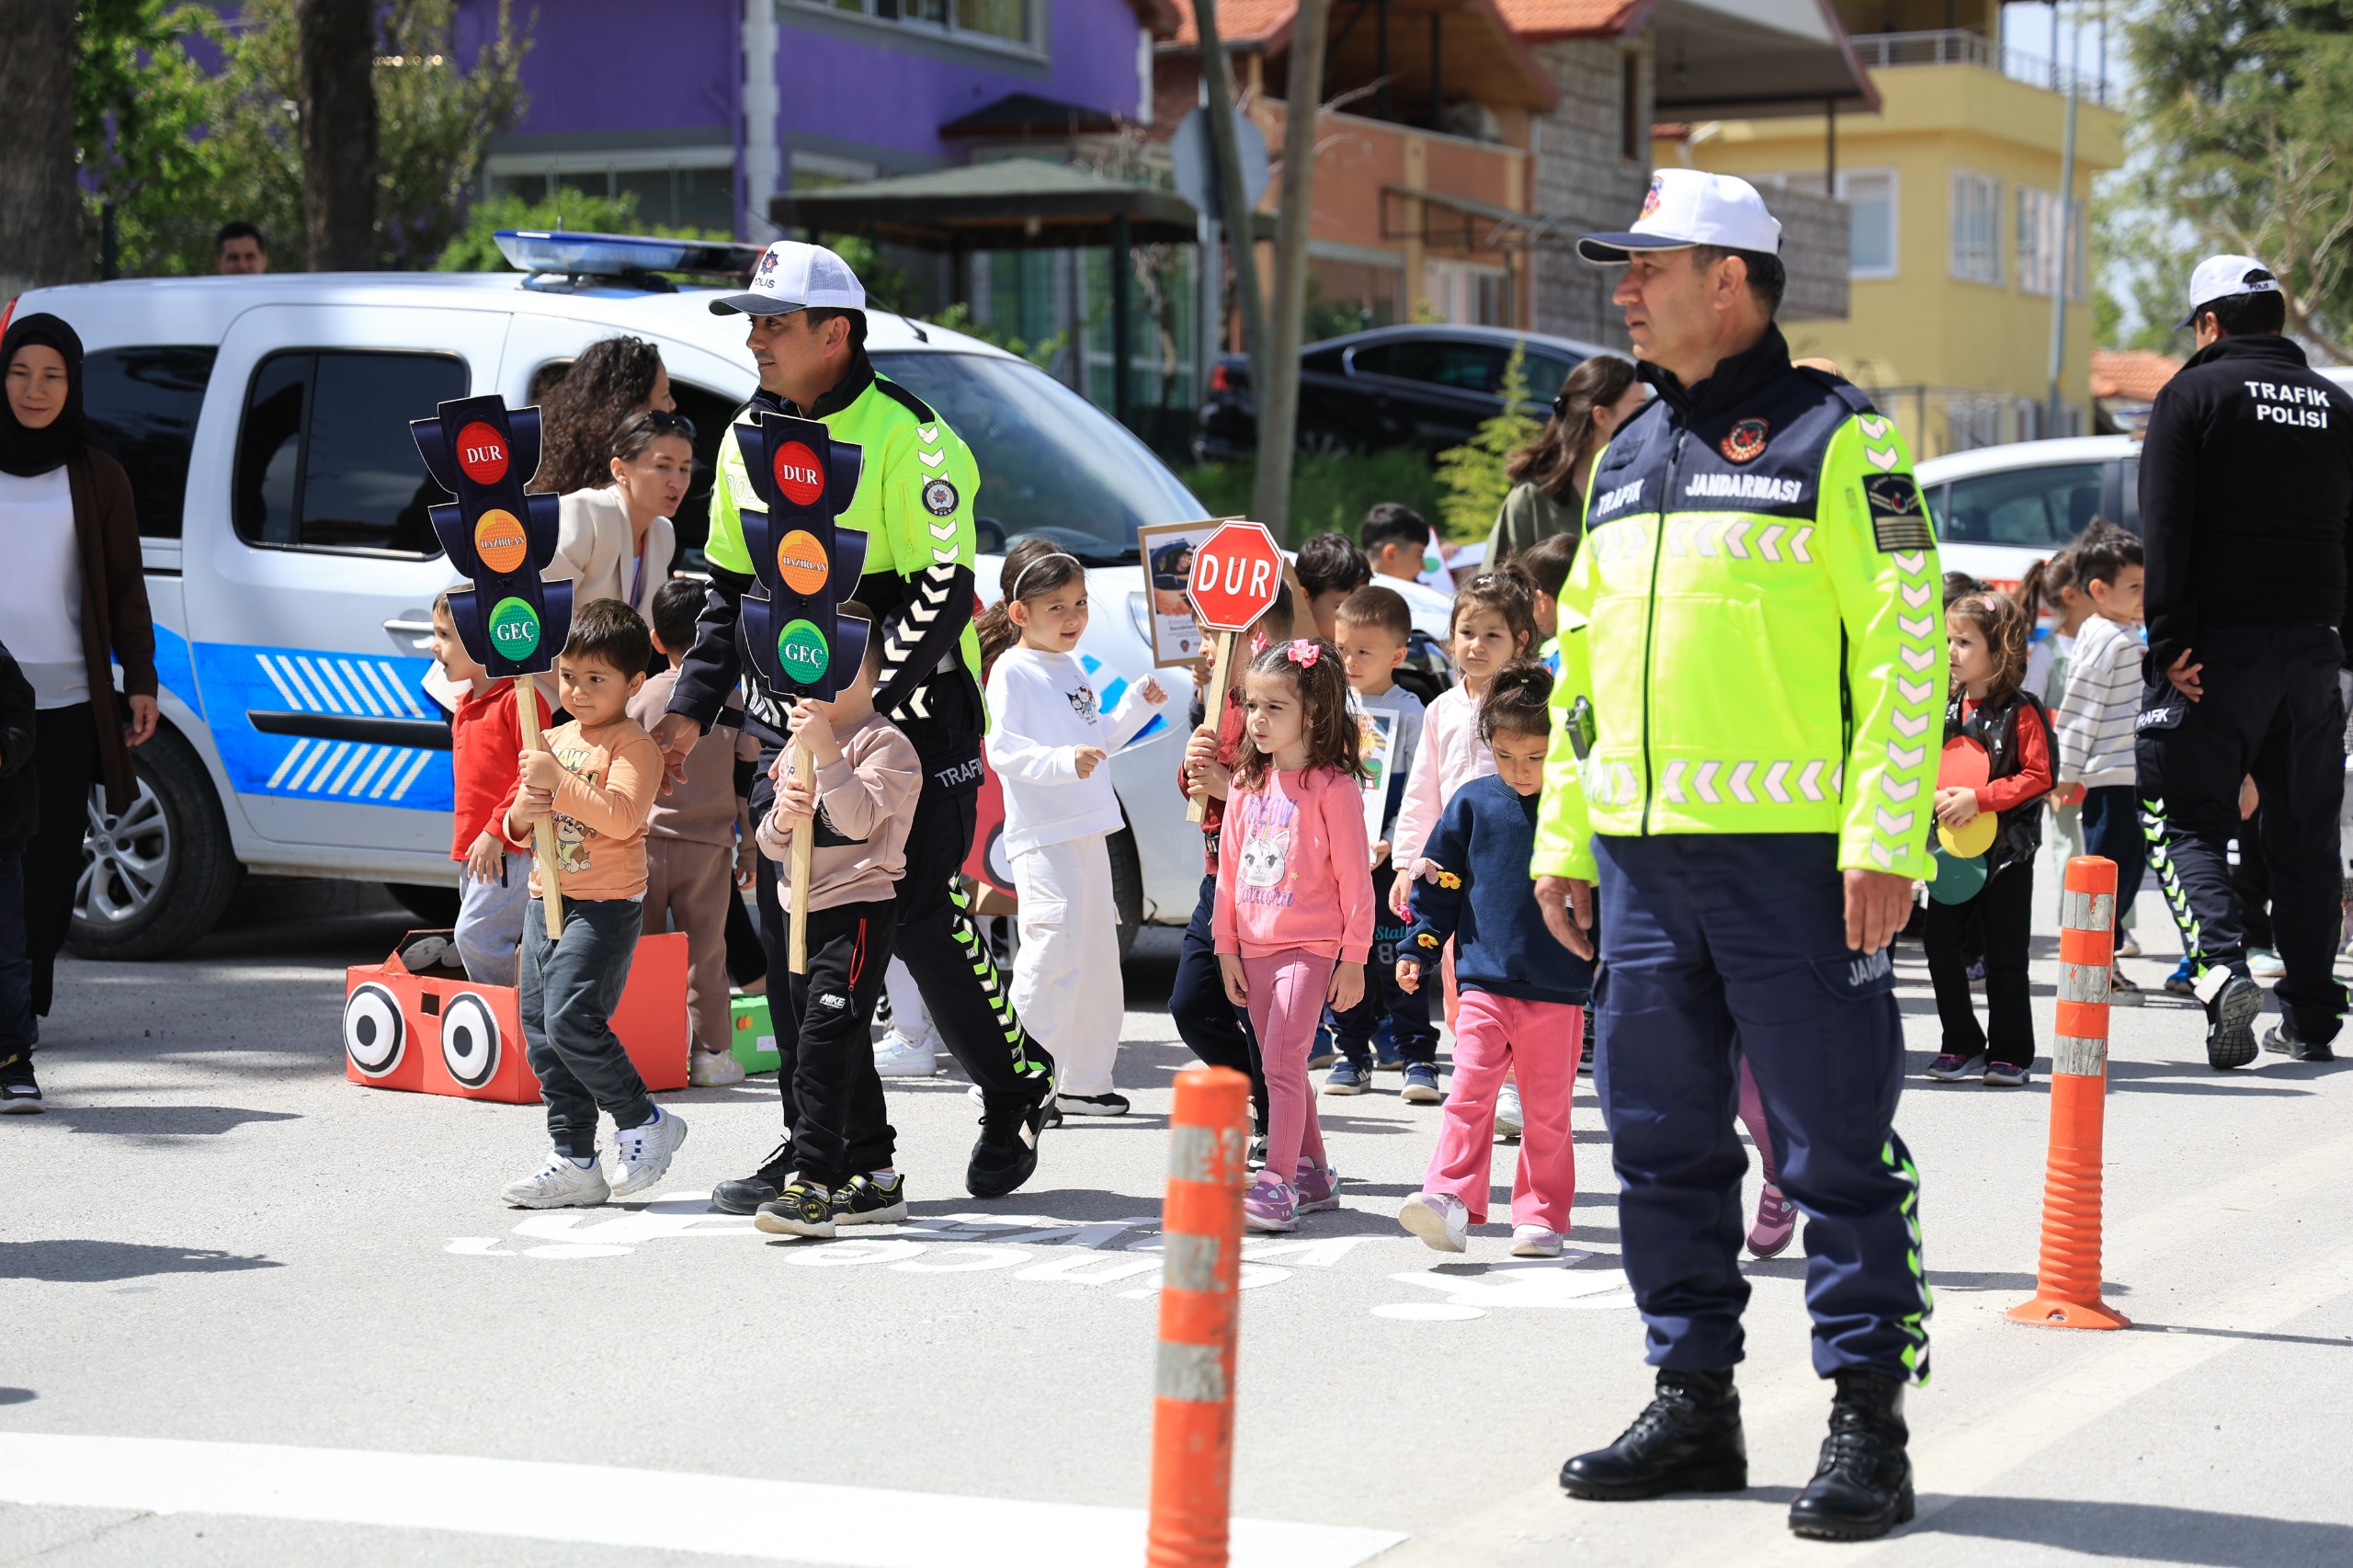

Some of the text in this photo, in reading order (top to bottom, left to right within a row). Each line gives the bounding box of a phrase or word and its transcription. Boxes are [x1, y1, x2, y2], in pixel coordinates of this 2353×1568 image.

[2245, 381, 2331, 408] TRAFİK
[2256, 403, 2328, 429] POLİSİ
[466, 444, 504, 464] DUR
[783, 464, 819, 485] DUR
[1685, 473, 1802, 503] JANDARMASI
[480, 535, 526, 550] HAZIRLAN
[782, 555, 827, 573] HAZIRLAN
[1198, 553, 1270, 598] DUR
[496, 620, 535, 642] GEÇ
[785, 642, 824, 669] GEÇ
[821, 993, 846, 1007] NIKE
